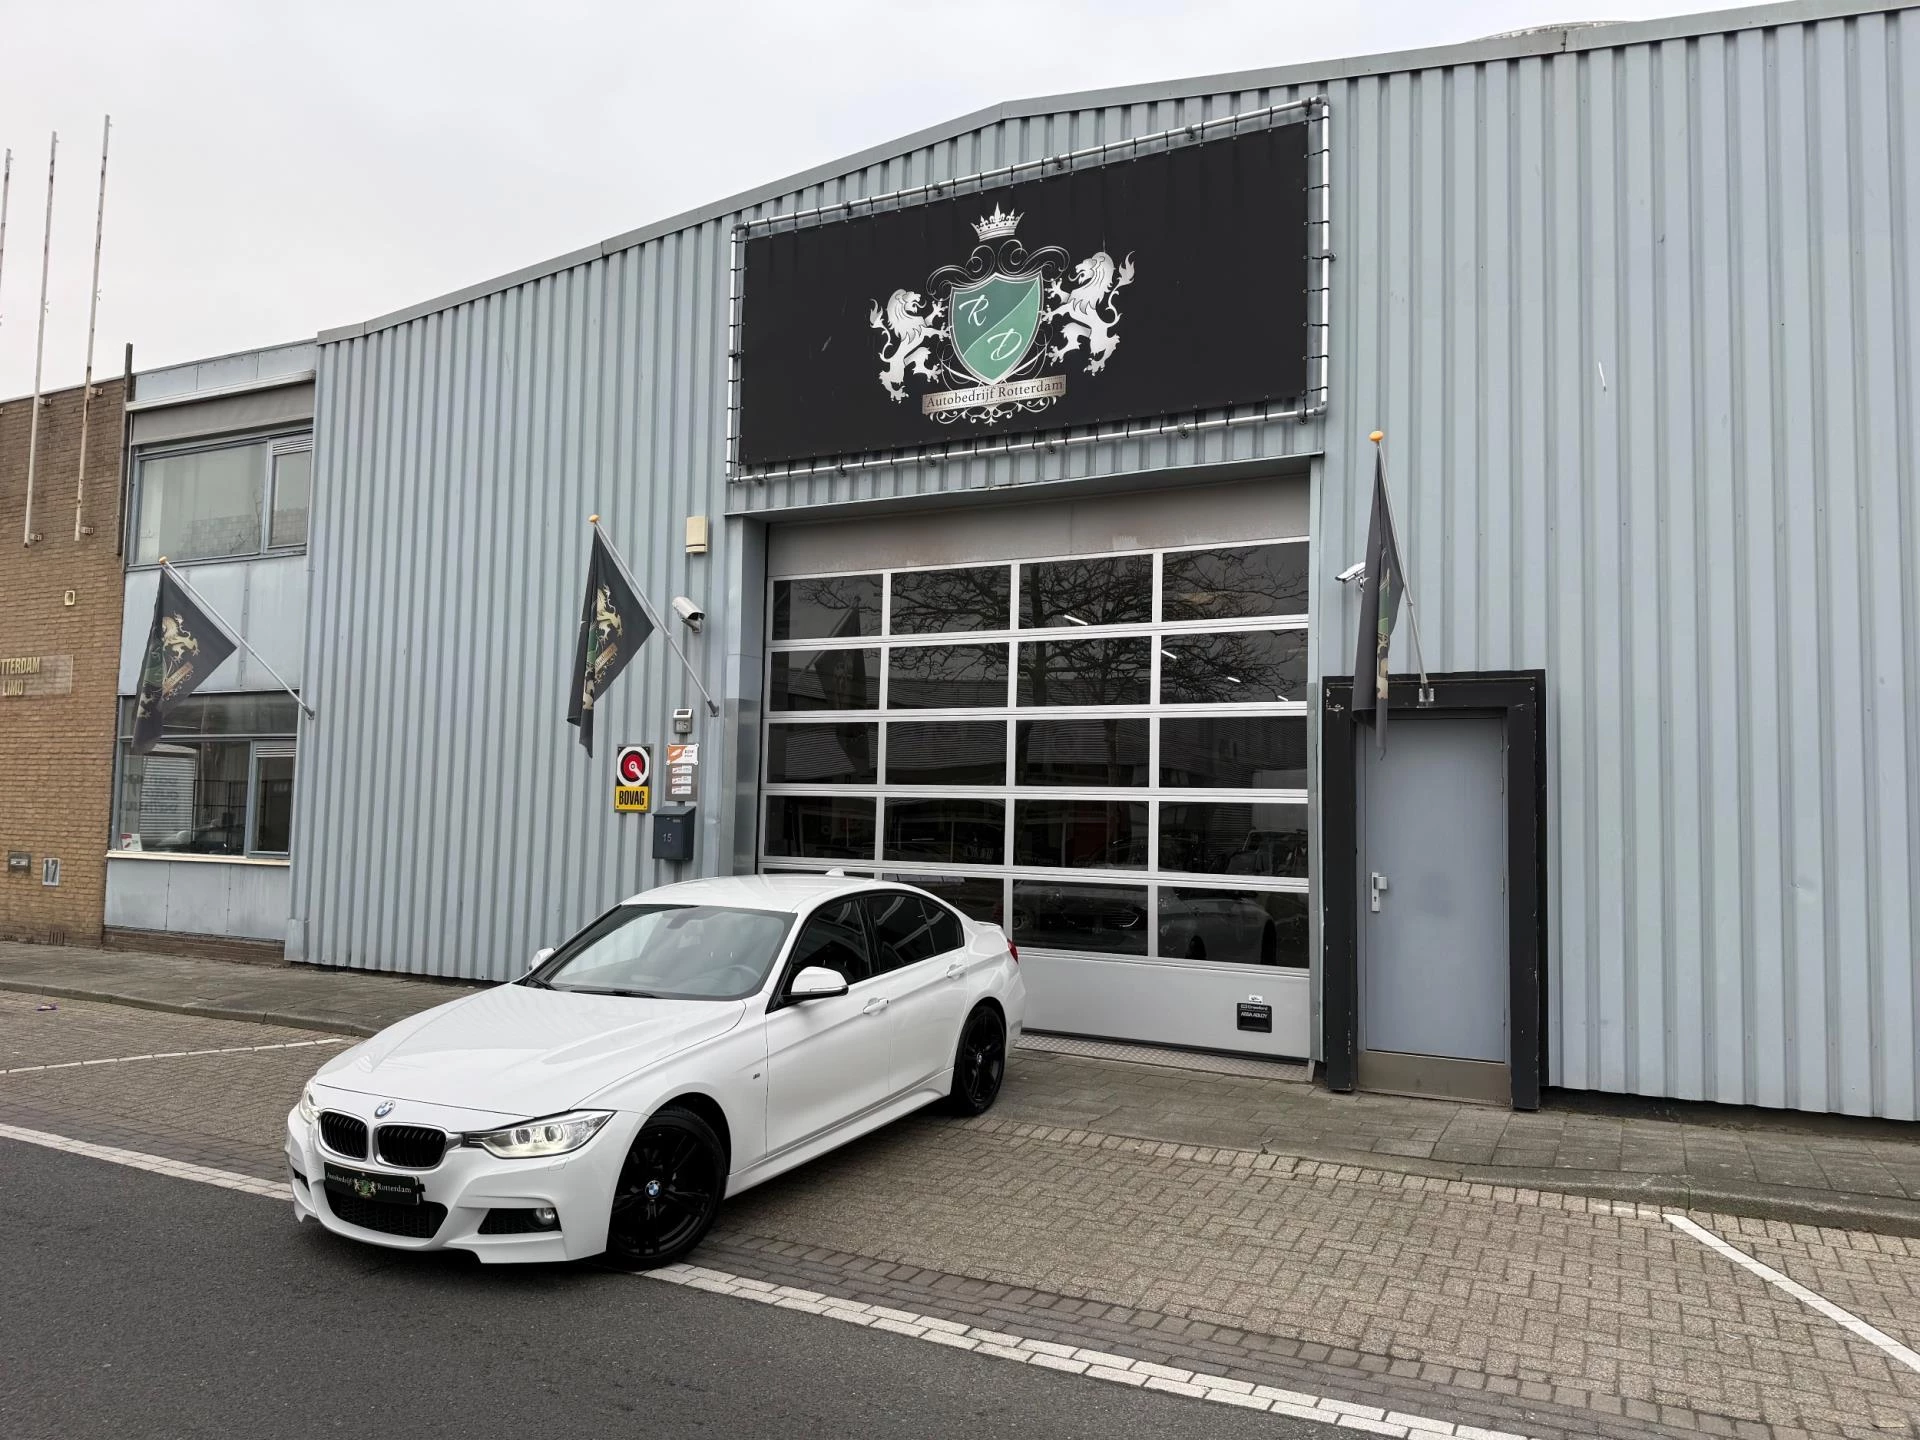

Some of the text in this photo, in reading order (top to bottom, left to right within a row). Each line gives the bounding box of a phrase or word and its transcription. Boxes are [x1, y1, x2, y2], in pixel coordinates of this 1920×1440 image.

[958, 294, 990, 327] R
[986, 328, 1023, 361] D
[926, 380, 1063, 408] Autobedrijf Rotterdam
[2, 679, 24, 696] LIMO
[618, 790, 645, 806] BOVAG
[662, 833, 673, 843] 15
[44, 859, 59, 883] 17
[377, 1183, 412, 1193] Rotterdam
